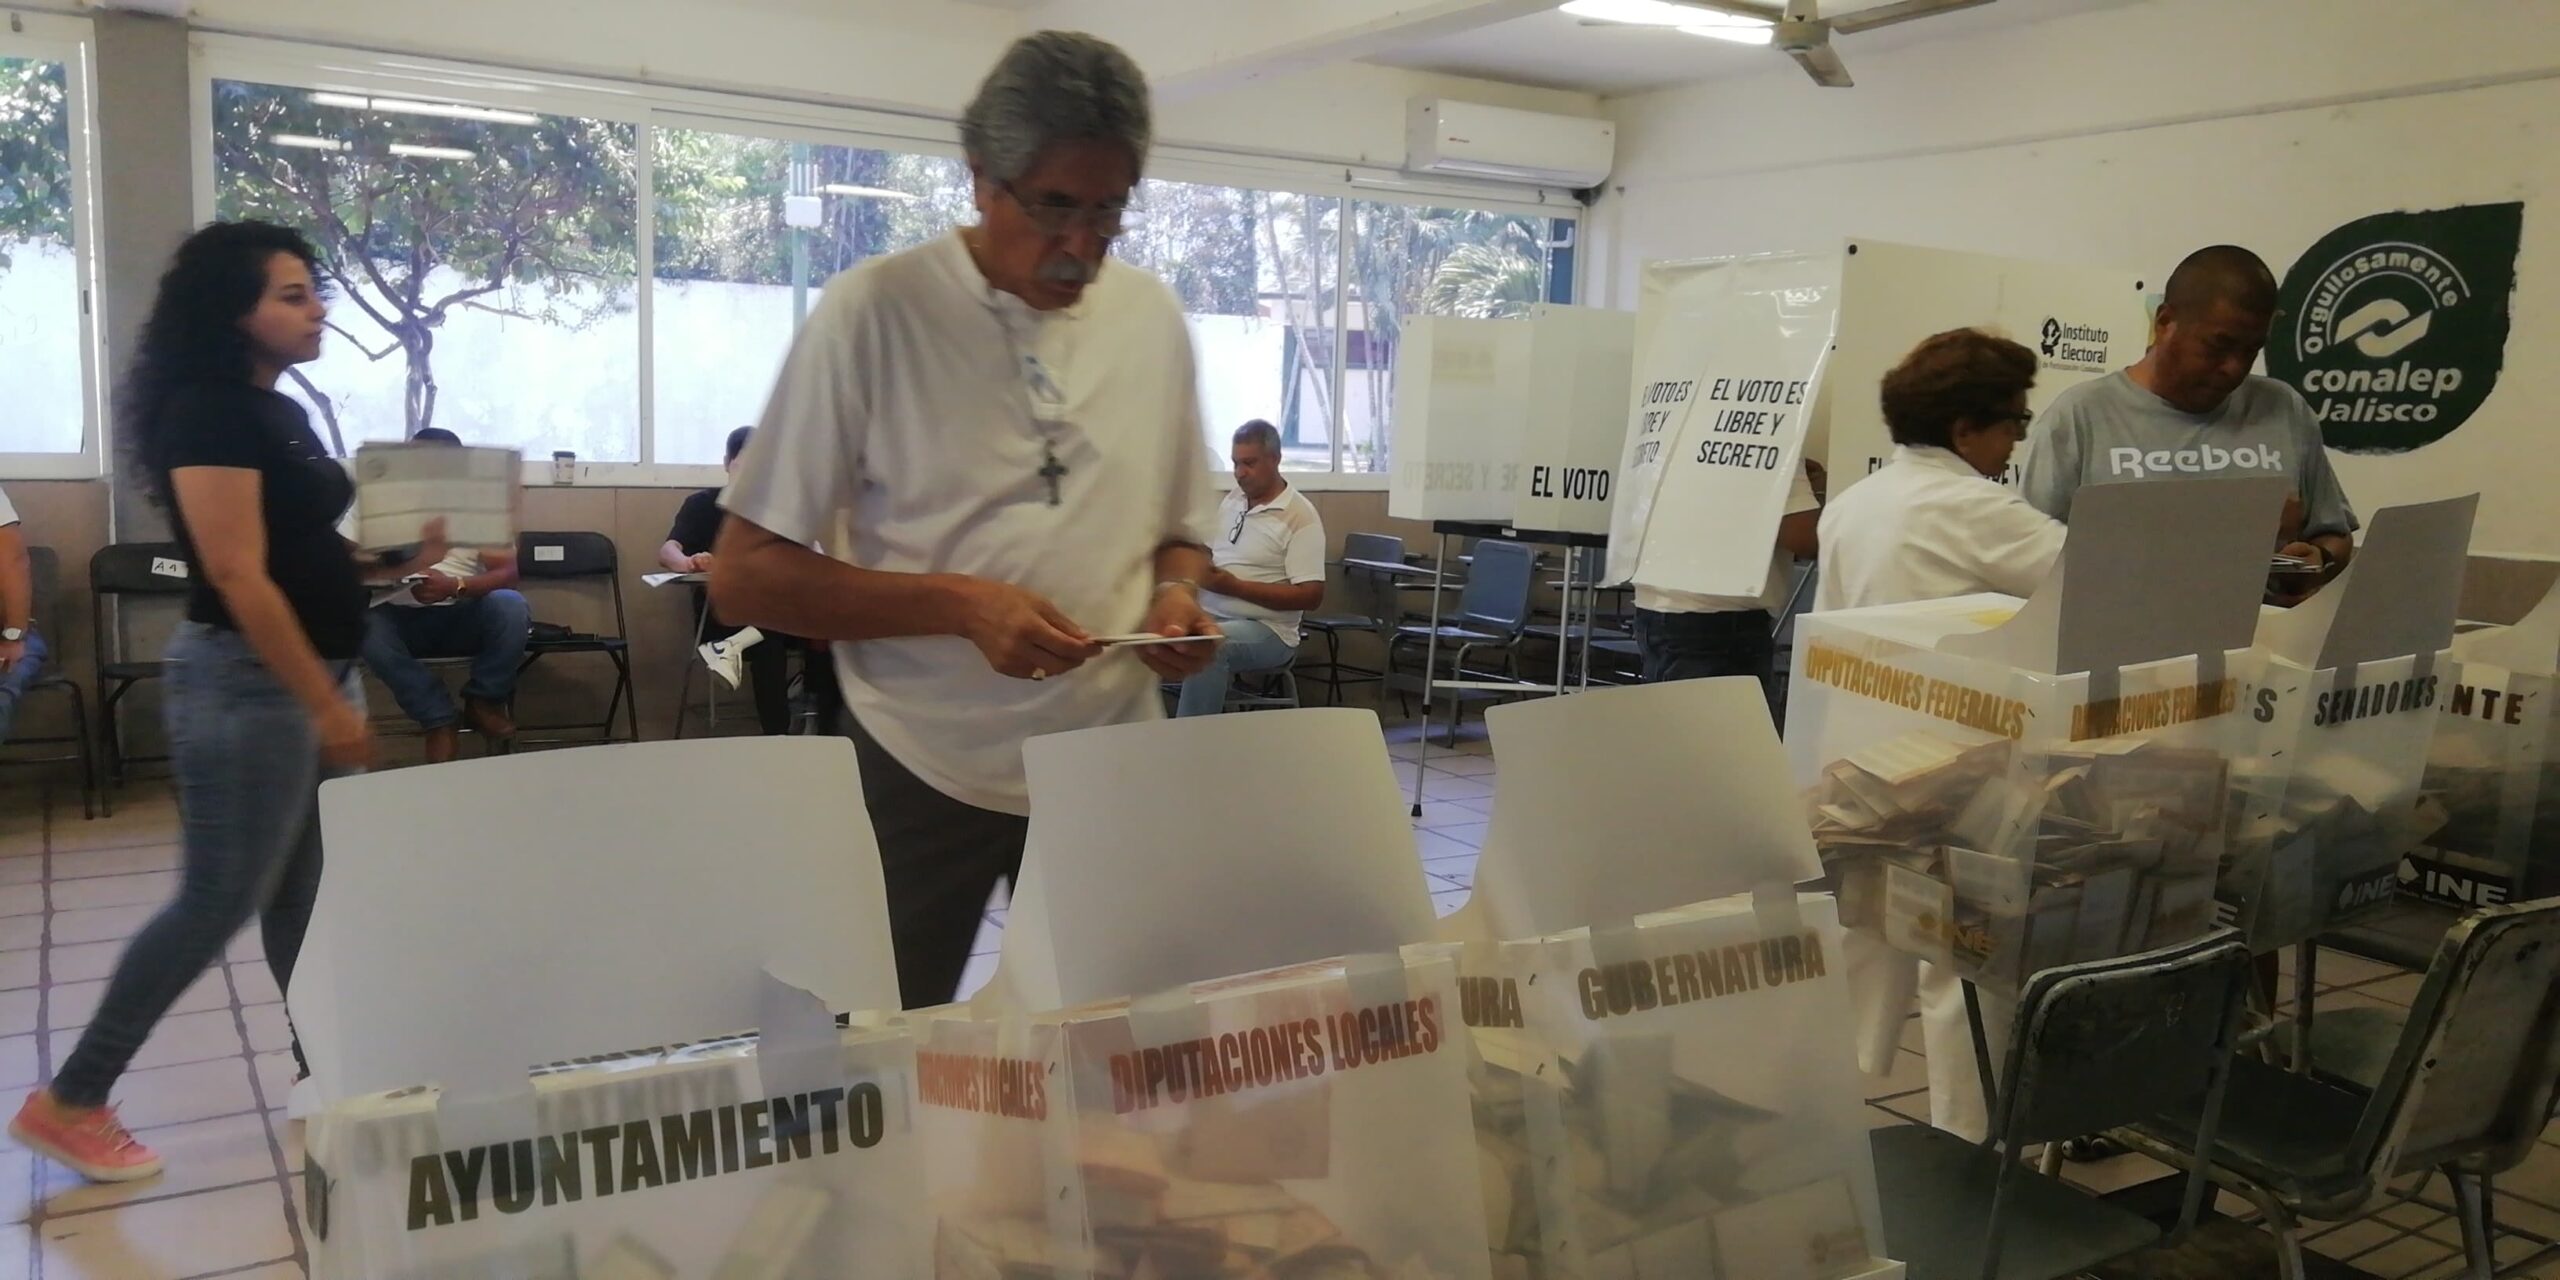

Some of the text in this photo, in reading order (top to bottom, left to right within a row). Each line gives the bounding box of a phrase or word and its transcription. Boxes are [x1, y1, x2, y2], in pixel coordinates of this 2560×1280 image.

[2303, 251, 2458, 354] Orgullosamente
[2063, 322, 2108, 343] Instituto
[2061, 343, 2107, 363] Electoral
[1710, 378, 1809, 405] EL VOTO ES
[2303, 360, 2463, 398] conalep
[1713, 409, 1785, 436] LIBRE Y
[2317, 398, 2438, 422] Jalisco
[1697, 440, 1779, 470] SECRETO
[2110, 443, 2283, 479] Reebok
[1531, 465, 1610, 501] EL VOTO
[1806, 645, 2027, 740] DIPUTACIONES FEDERALES
[2314, 675, 2438, 727] SENADORES
[2425, 870, 2508, 909] INE
[1577, 931, 1827, 1021] GUBERNATURA
[1456, 976, 1525, 1029] URA
[1110, 996, 1438, 1115] DIPUTACIONES LOCALES
[982, 1056, 1047, 1122] LOCALES
[406, 1082, 885, 1231] AYUNTAMIENTO
